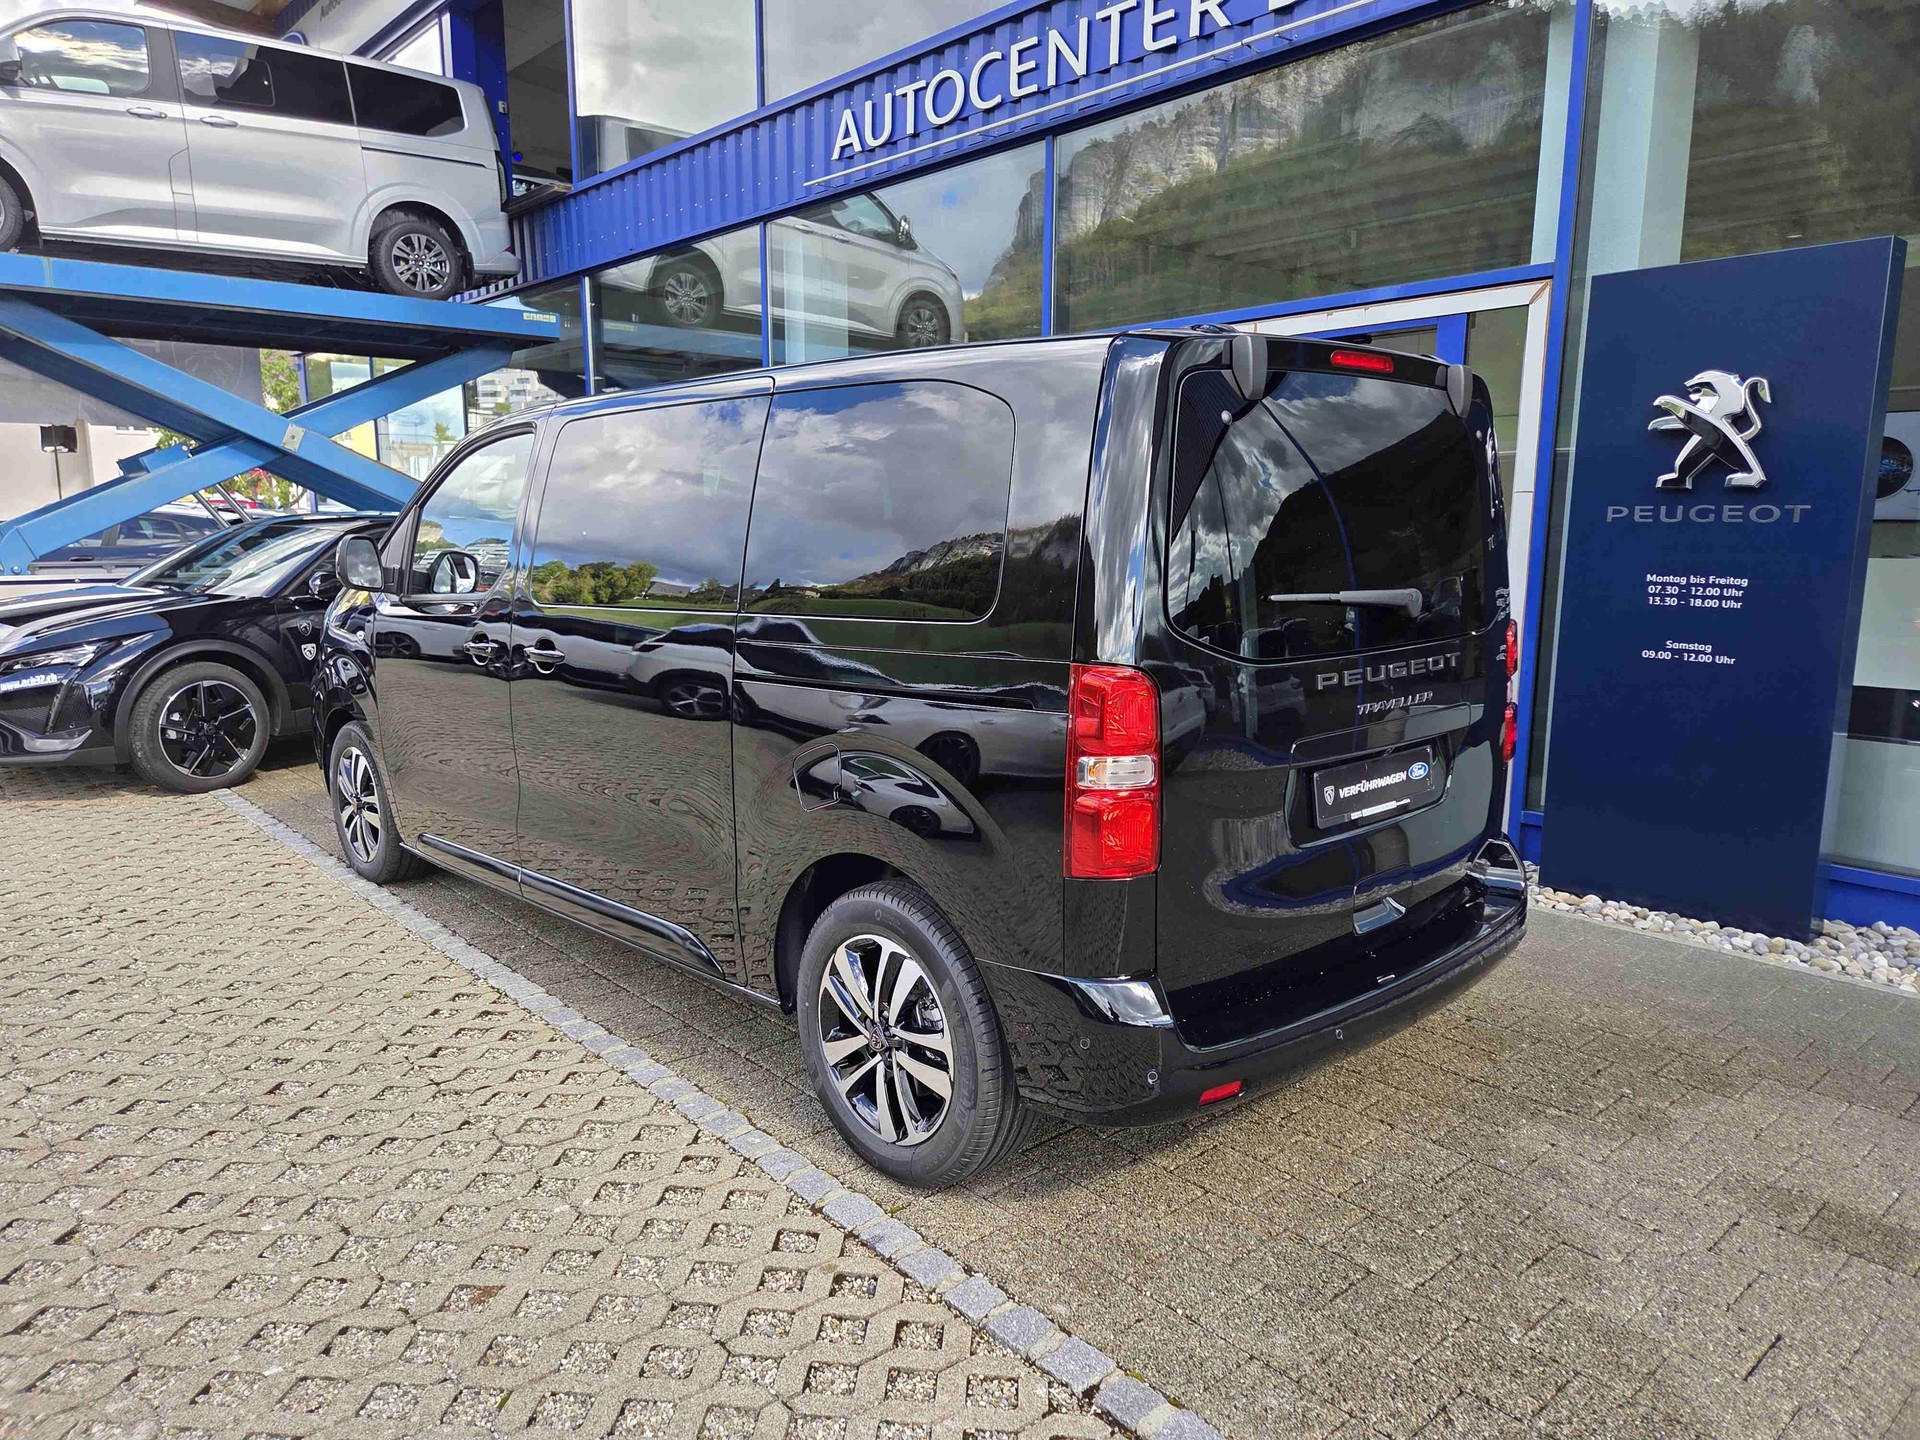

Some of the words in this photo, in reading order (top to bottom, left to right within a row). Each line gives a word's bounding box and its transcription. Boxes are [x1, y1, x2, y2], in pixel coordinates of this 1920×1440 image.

[831, 0, 1232, 161] AUTOCENTER
[1606, 504, 1812, 524] PEUGEOT
[1646, 574, 1687, 585] Montag
[1689, 575, 1706, 584] bis
[1708, 576, 1749, 587] Freitag
[1648, 585, 1679, 594] 07.30
[1690, 587, 1721, 596] 12.00
[1723, 588, 1744, 597] Uhr
[1648, 597, 1678, 606] 13.30
[1689, 598, 1719, 608] 18.00
[1721, 600, 1743, 609] Uhr
[1665, 640, 1712, 653] Samstag
[1641, 650, 1672, 660] 09.00
[1683, 653, 1713, 663] 12.00
[1715, 655, 1736, 665] Uhr
[1316, 652, 1461, 690] PEUGEOT
[1357, 691, 1433, 715] TRAVELLER
[1339, 770, 1407, 799] VERFÜHRWAGEN
